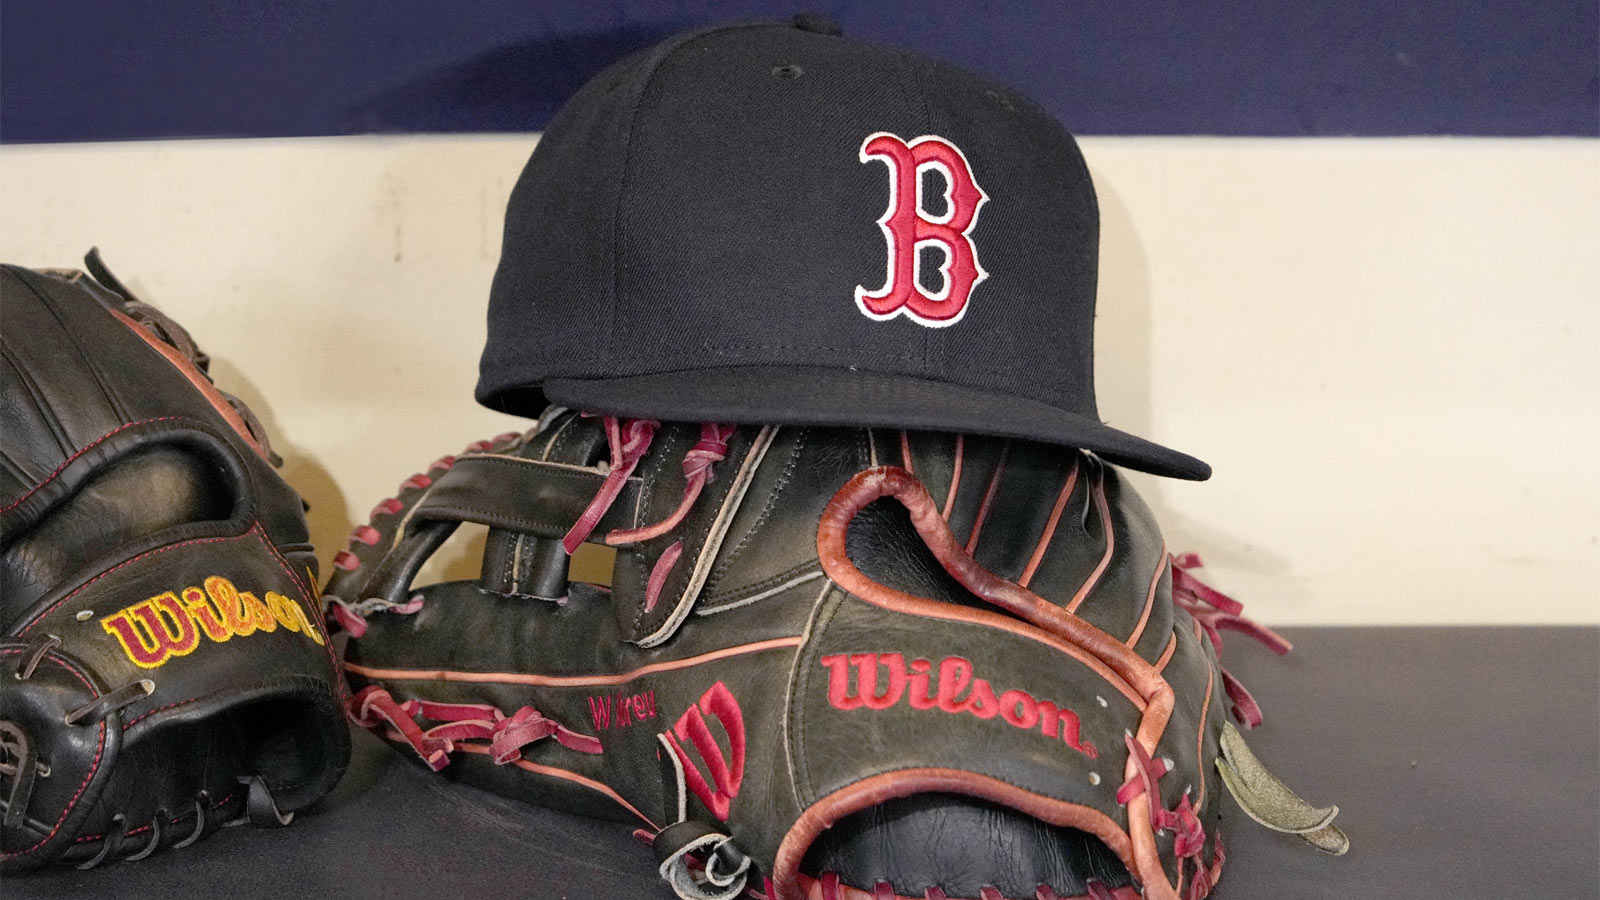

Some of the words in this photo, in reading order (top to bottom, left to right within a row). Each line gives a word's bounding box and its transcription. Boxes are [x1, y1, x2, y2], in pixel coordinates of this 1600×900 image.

[854, 131, 990, 328] B
[100, 576, 325, 669] Wilson
[616, 689, 657, 729] reu
[821, 652, 1086, 753] Wilson
